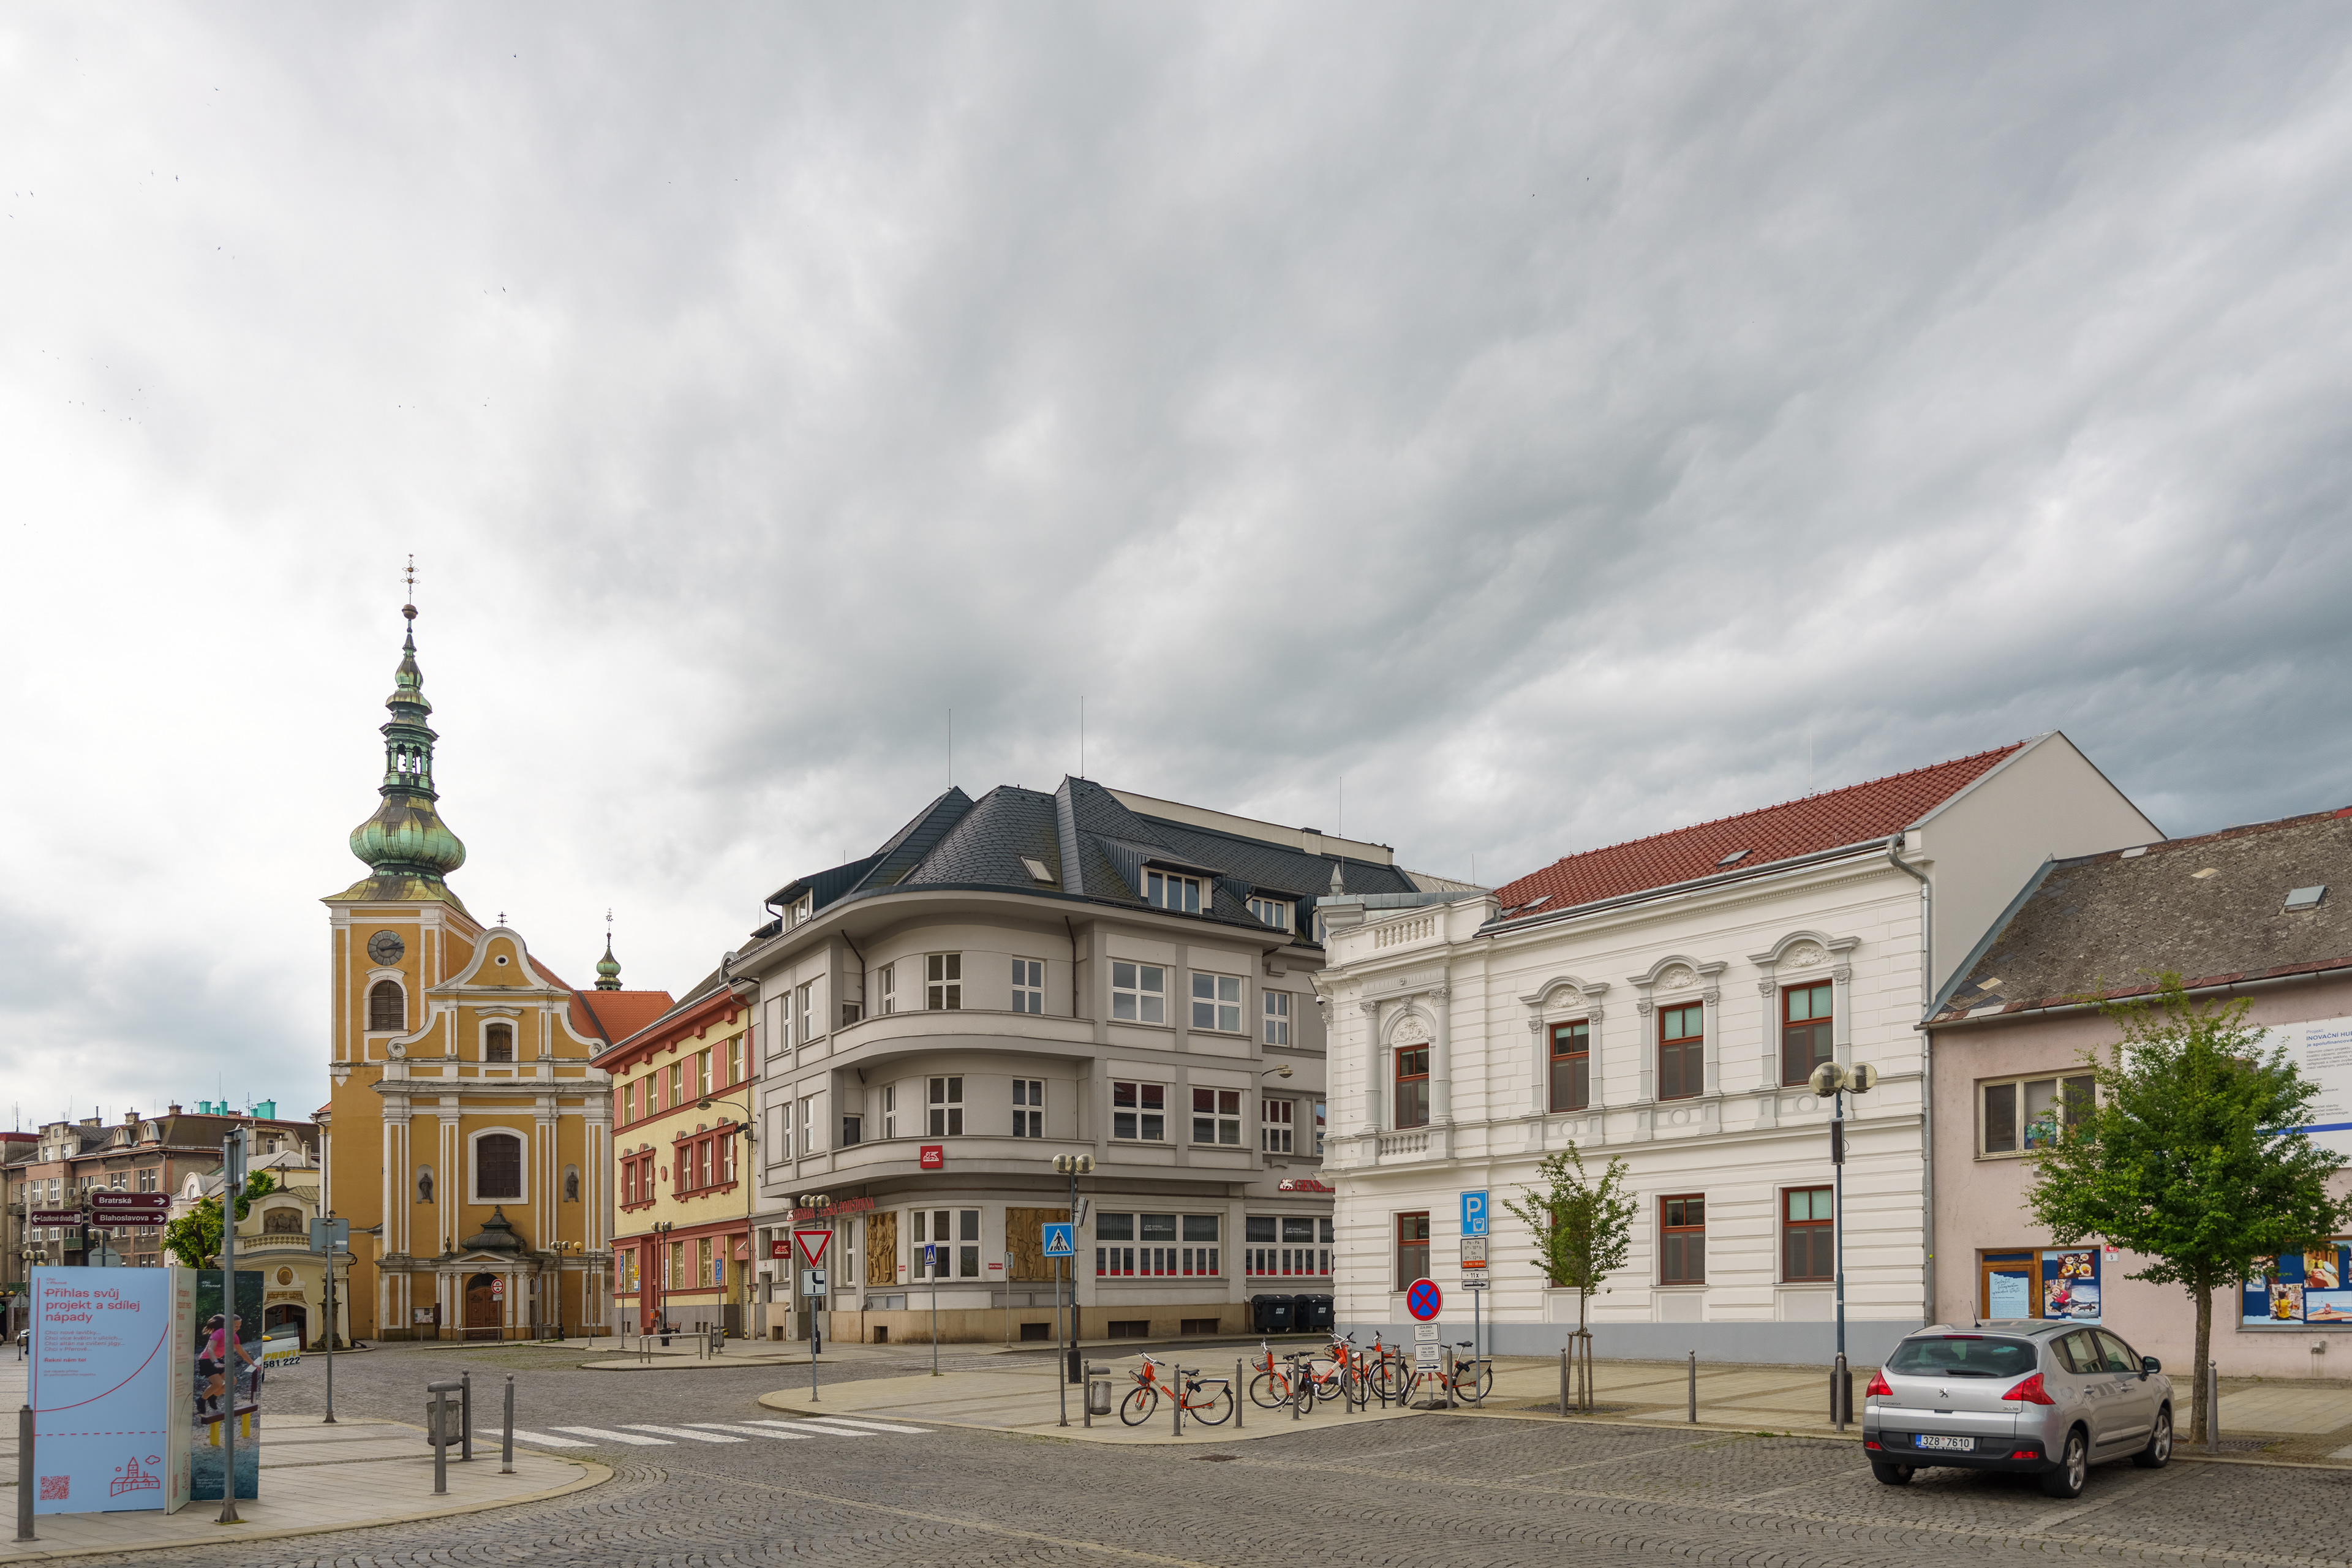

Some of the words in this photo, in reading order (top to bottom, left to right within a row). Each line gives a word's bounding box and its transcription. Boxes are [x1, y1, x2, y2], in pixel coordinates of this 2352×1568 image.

[2306, 1031, 2339, 1041] INOVAČNÍ
[1295, 1179, 1335, 1193] GENE
[839, 1196, 875, 1214] POJIŠŤOVNA
[1466, 1197, 1482, 1223] P
[716, 1261, 721, 1274] P
[44, 1288, 89, 1297] Přihlas
[94, 1288, 119, 1300] svůj
[46, 1300, 92, 1311] projekt
[108, 1300, 140, 1312] sdílej
[45, 1312, 93, 1324] nápady
[263, 1359, 280, 1368] 581
[283, 1357, 300, 1366] 222
[1923, 1436, 1940, 1446] 3Z8
[1947, 1438, 1969, 1447] 7610
